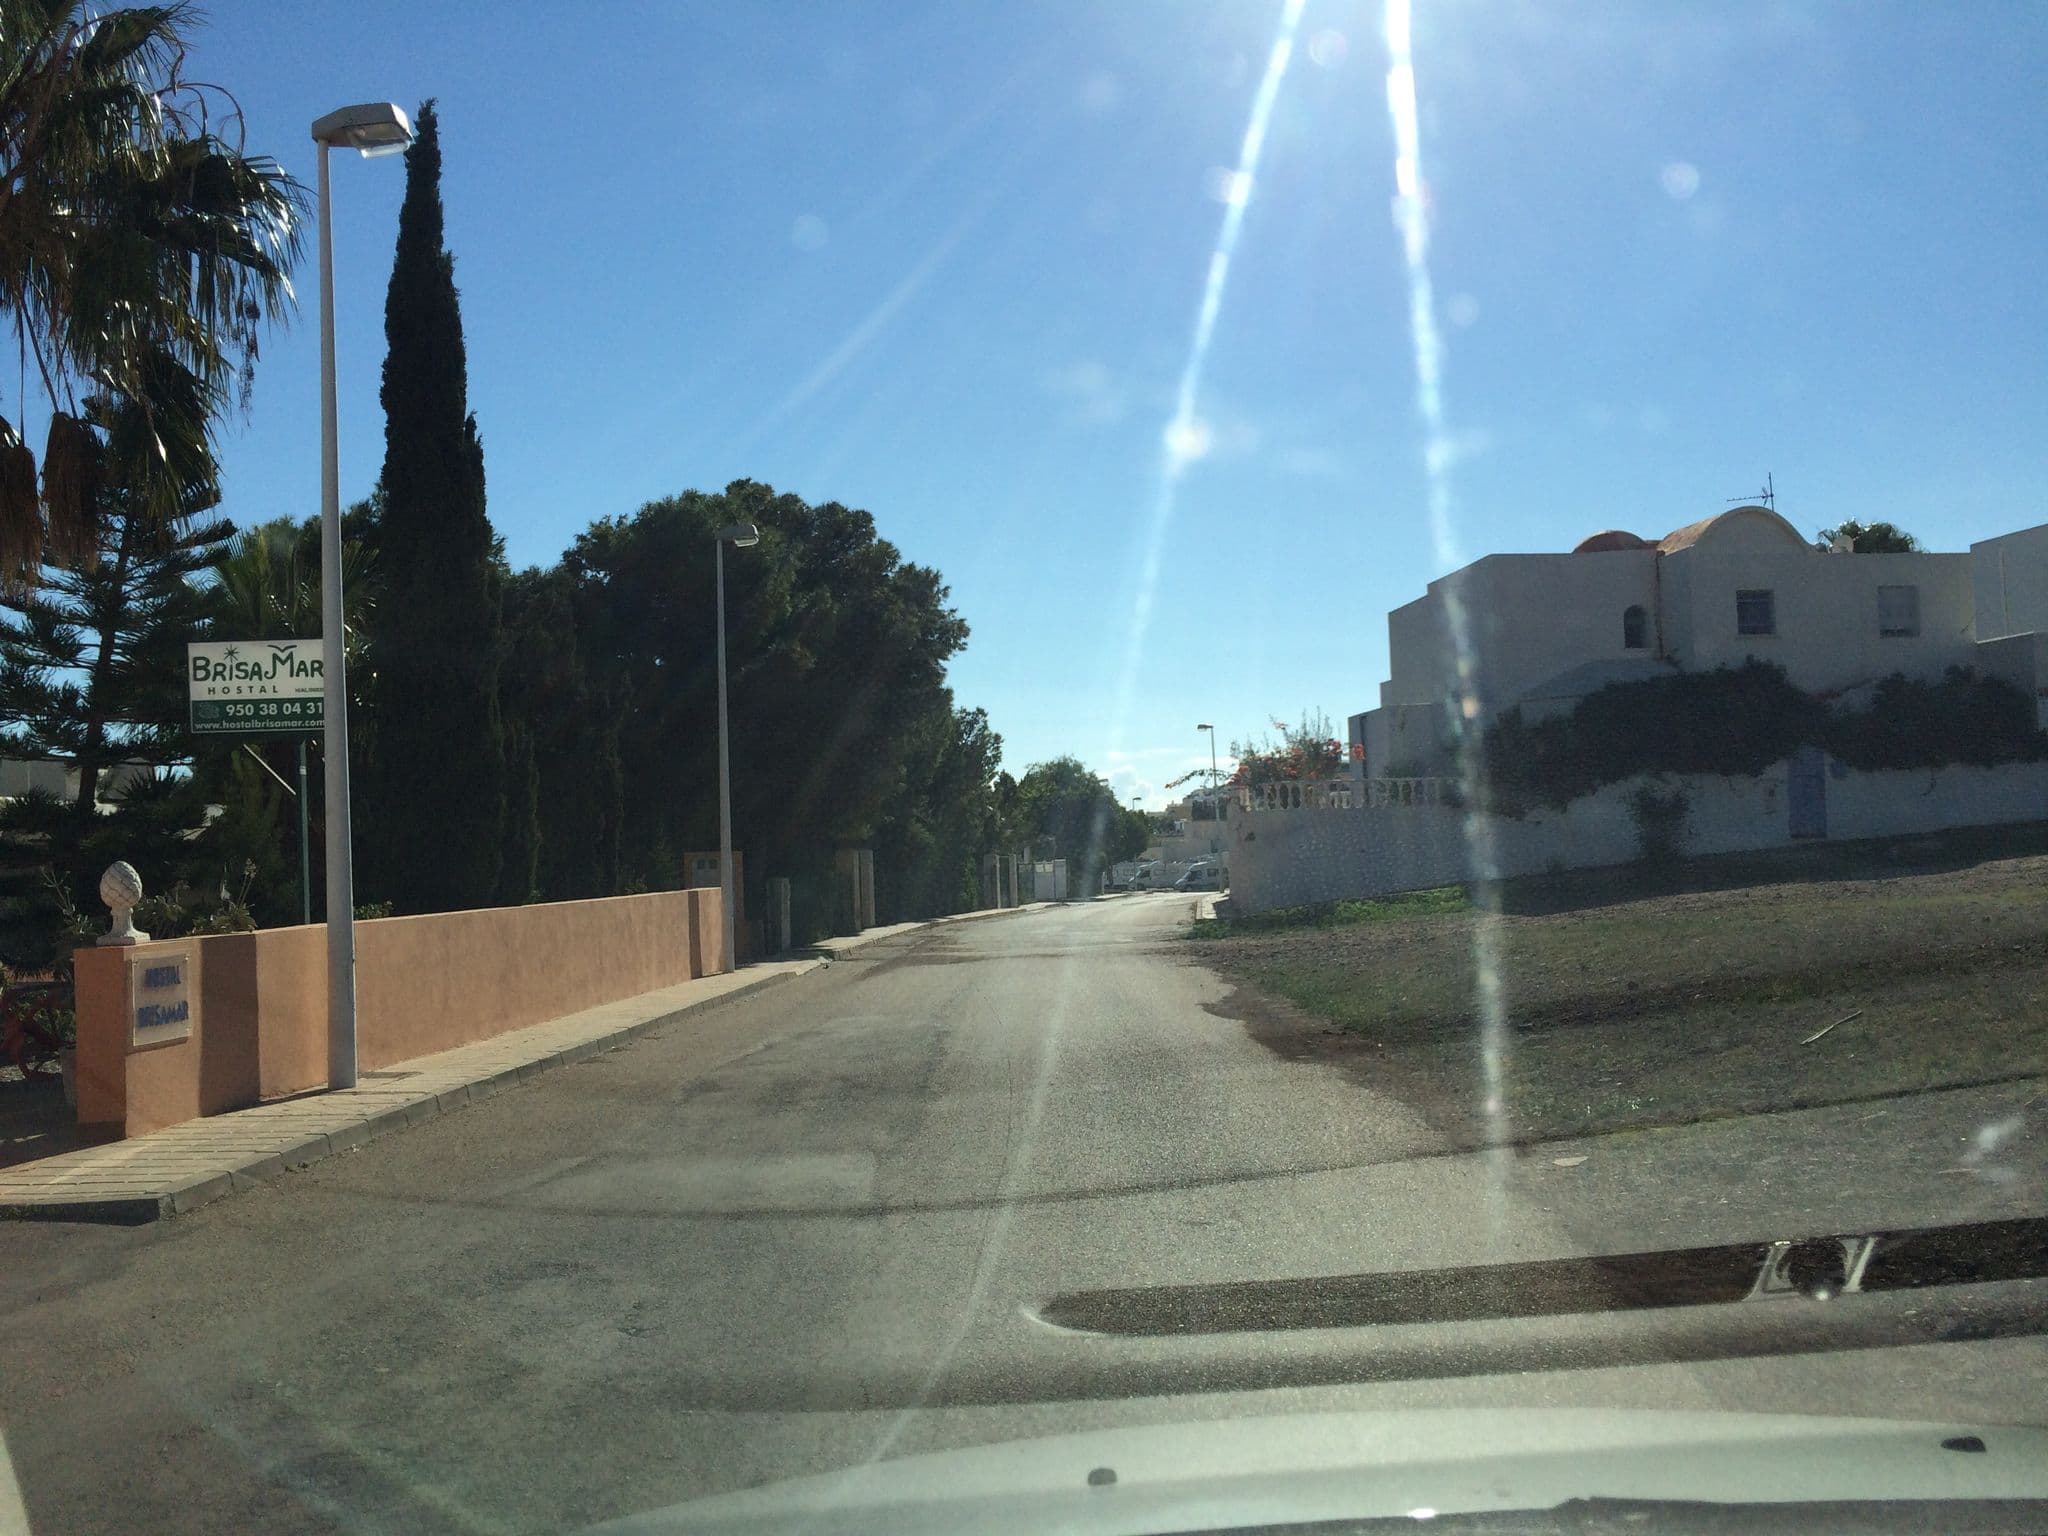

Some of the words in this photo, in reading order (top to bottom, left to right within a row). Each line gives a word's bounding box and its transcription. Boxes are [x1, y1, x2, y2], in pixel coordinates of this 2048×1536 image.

[207, 685, 279, 696] HOSTAL
[225, 703, 254, 717] 950
[259, 703, 278, 716] 38
[282, 702, 302, 715] 04
[306, 702, 323, 714] 31
[194, 719, 325, 730] www.hostalbrisamar.com
